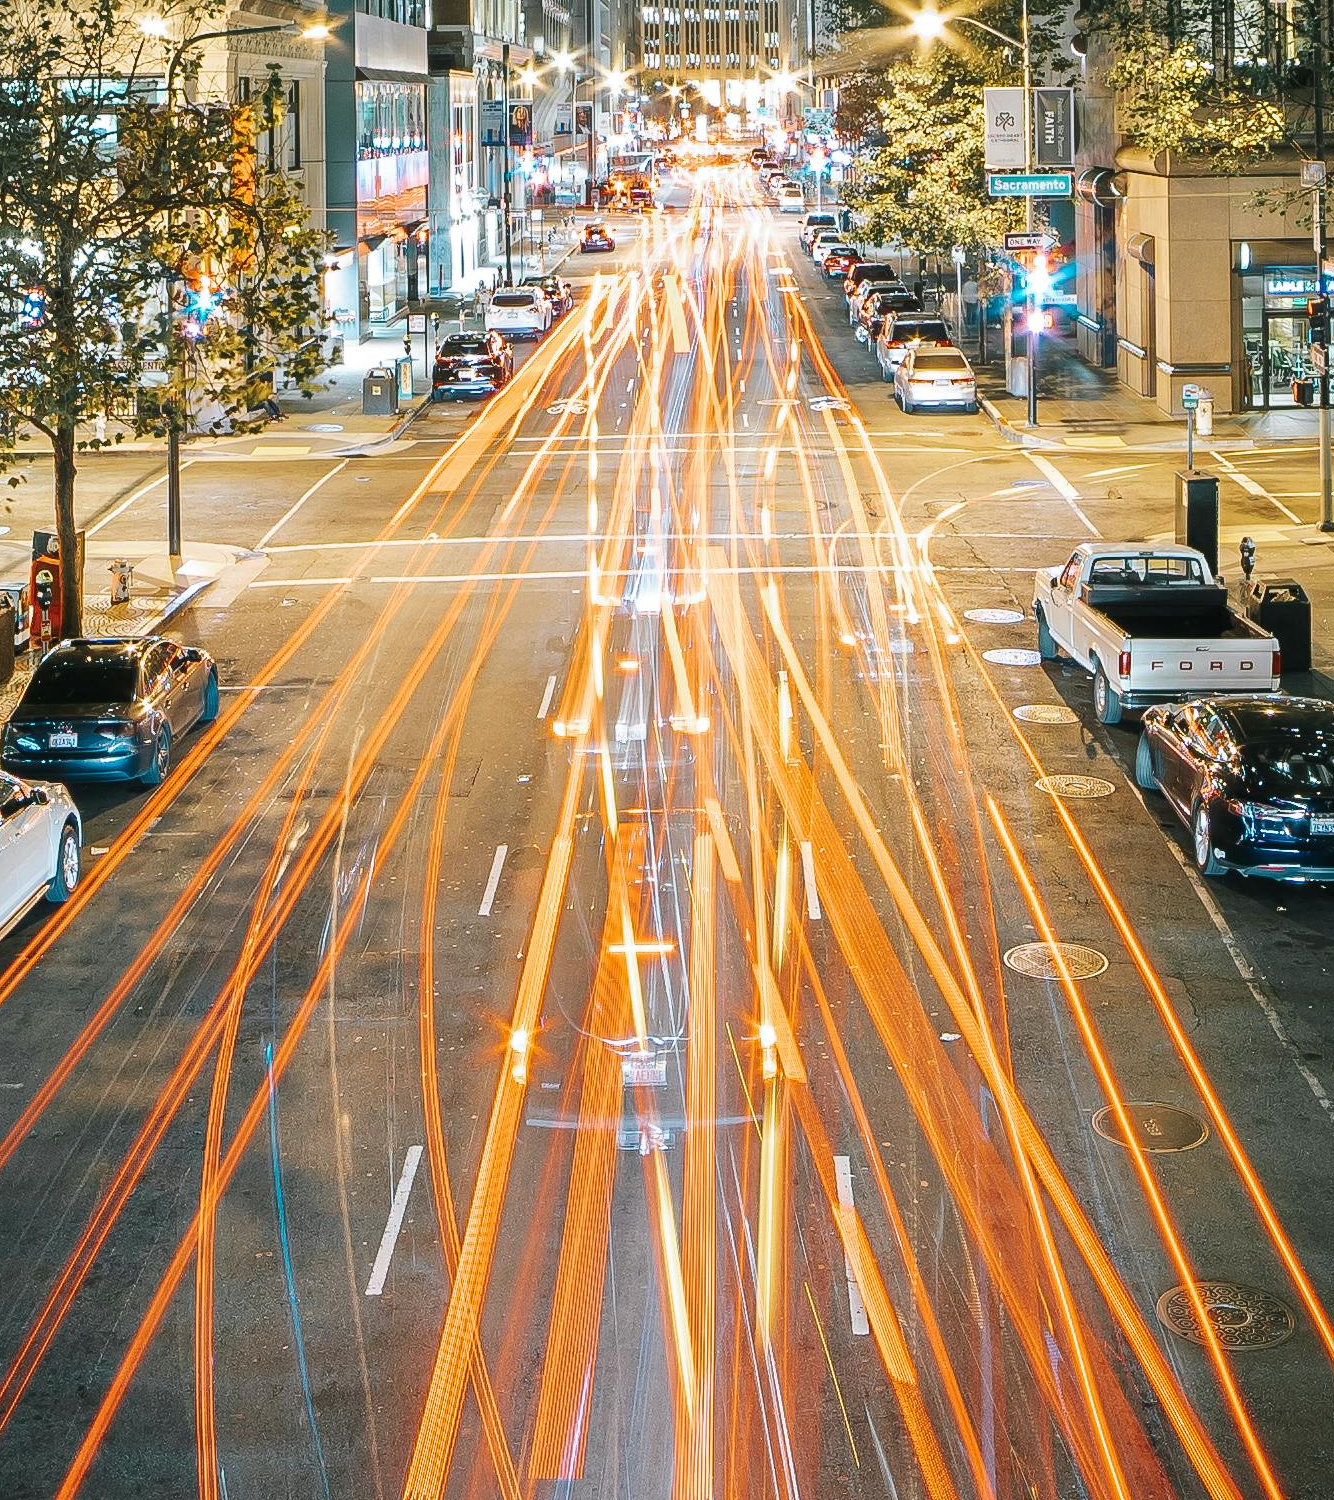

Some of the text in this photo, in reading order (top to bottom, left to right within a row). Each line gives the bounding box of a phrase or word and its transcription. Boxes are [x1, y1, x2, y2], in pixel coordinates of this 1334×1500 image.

[1045, 111, 1055, 144] FAITH
[994, 179, 1066, 191] Sacramento
[1009, 238, 1025, 246] ONE
[1151, 661, 1254, 671] FORD
